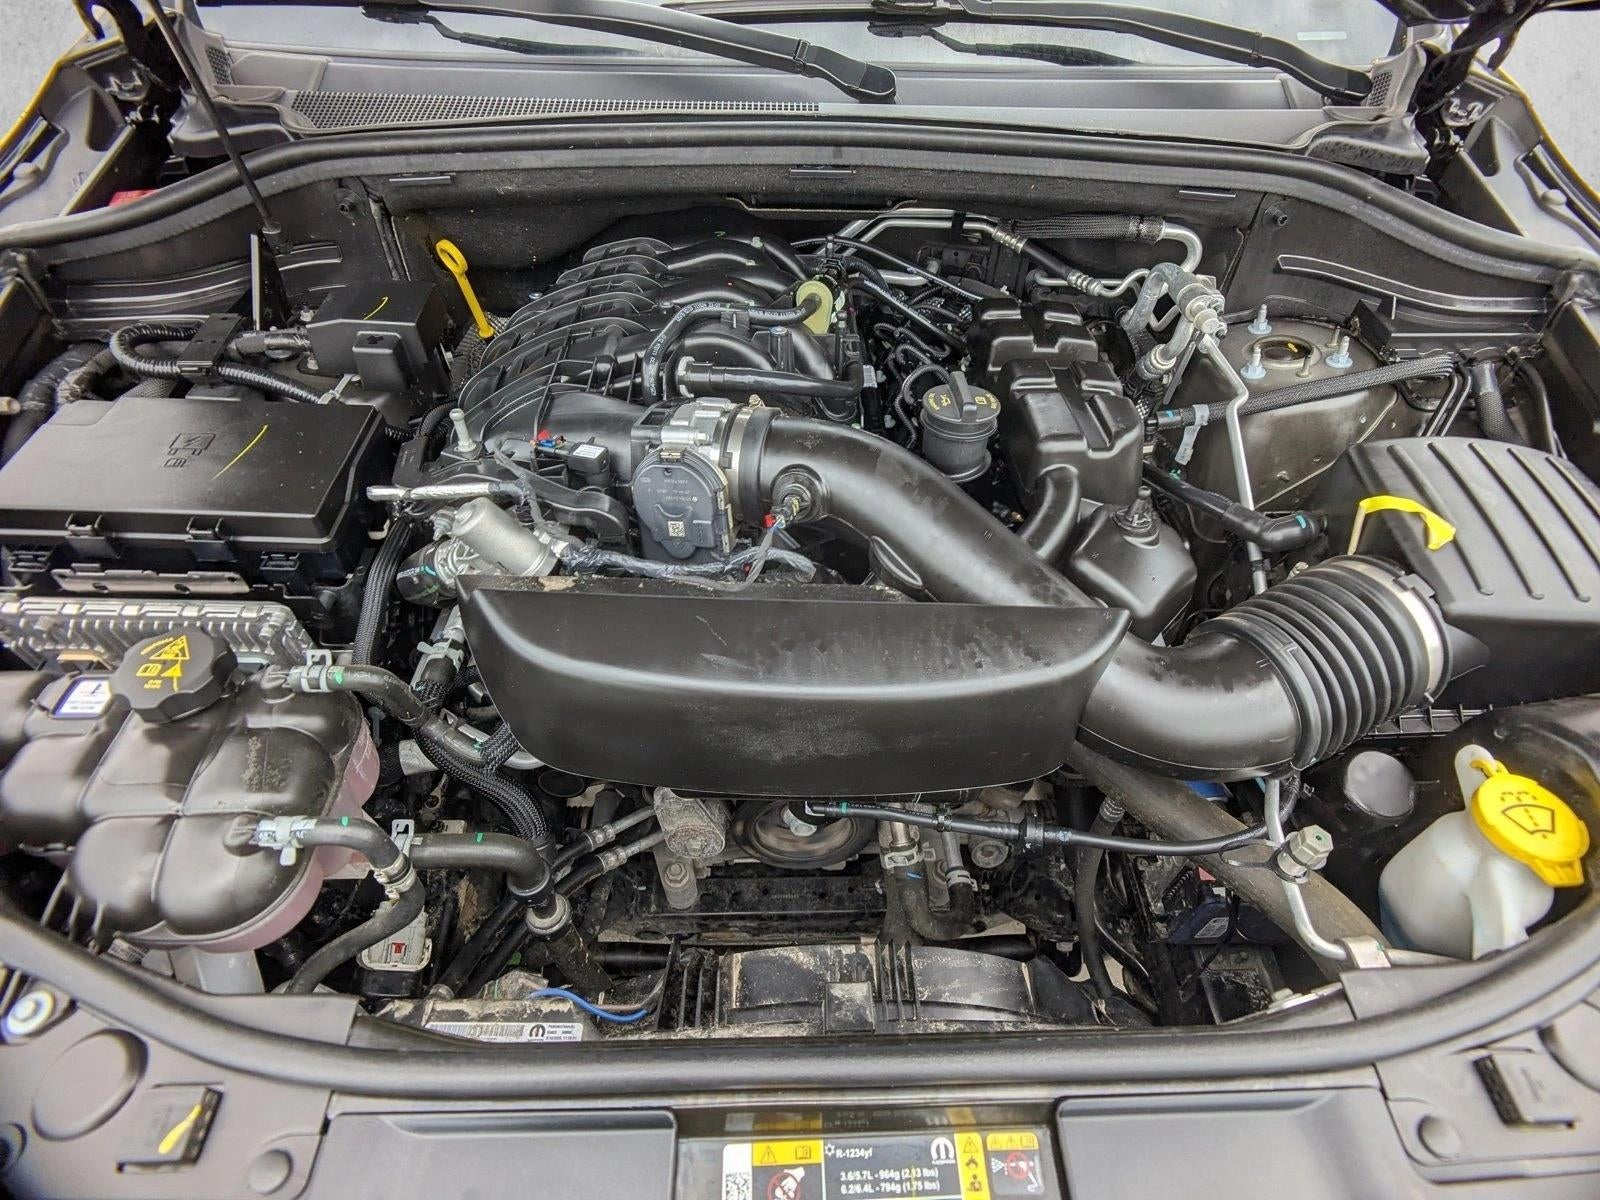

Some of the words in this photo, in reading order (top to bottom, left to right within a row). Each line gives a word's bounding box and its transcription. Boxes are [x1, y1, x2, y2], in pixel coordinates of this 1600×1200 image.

[836, 1147, 873, 1159] R-1234yf
[922, 1167, 939, 1178] lbs)
[923, 1180, 940, 1191] lbs)
